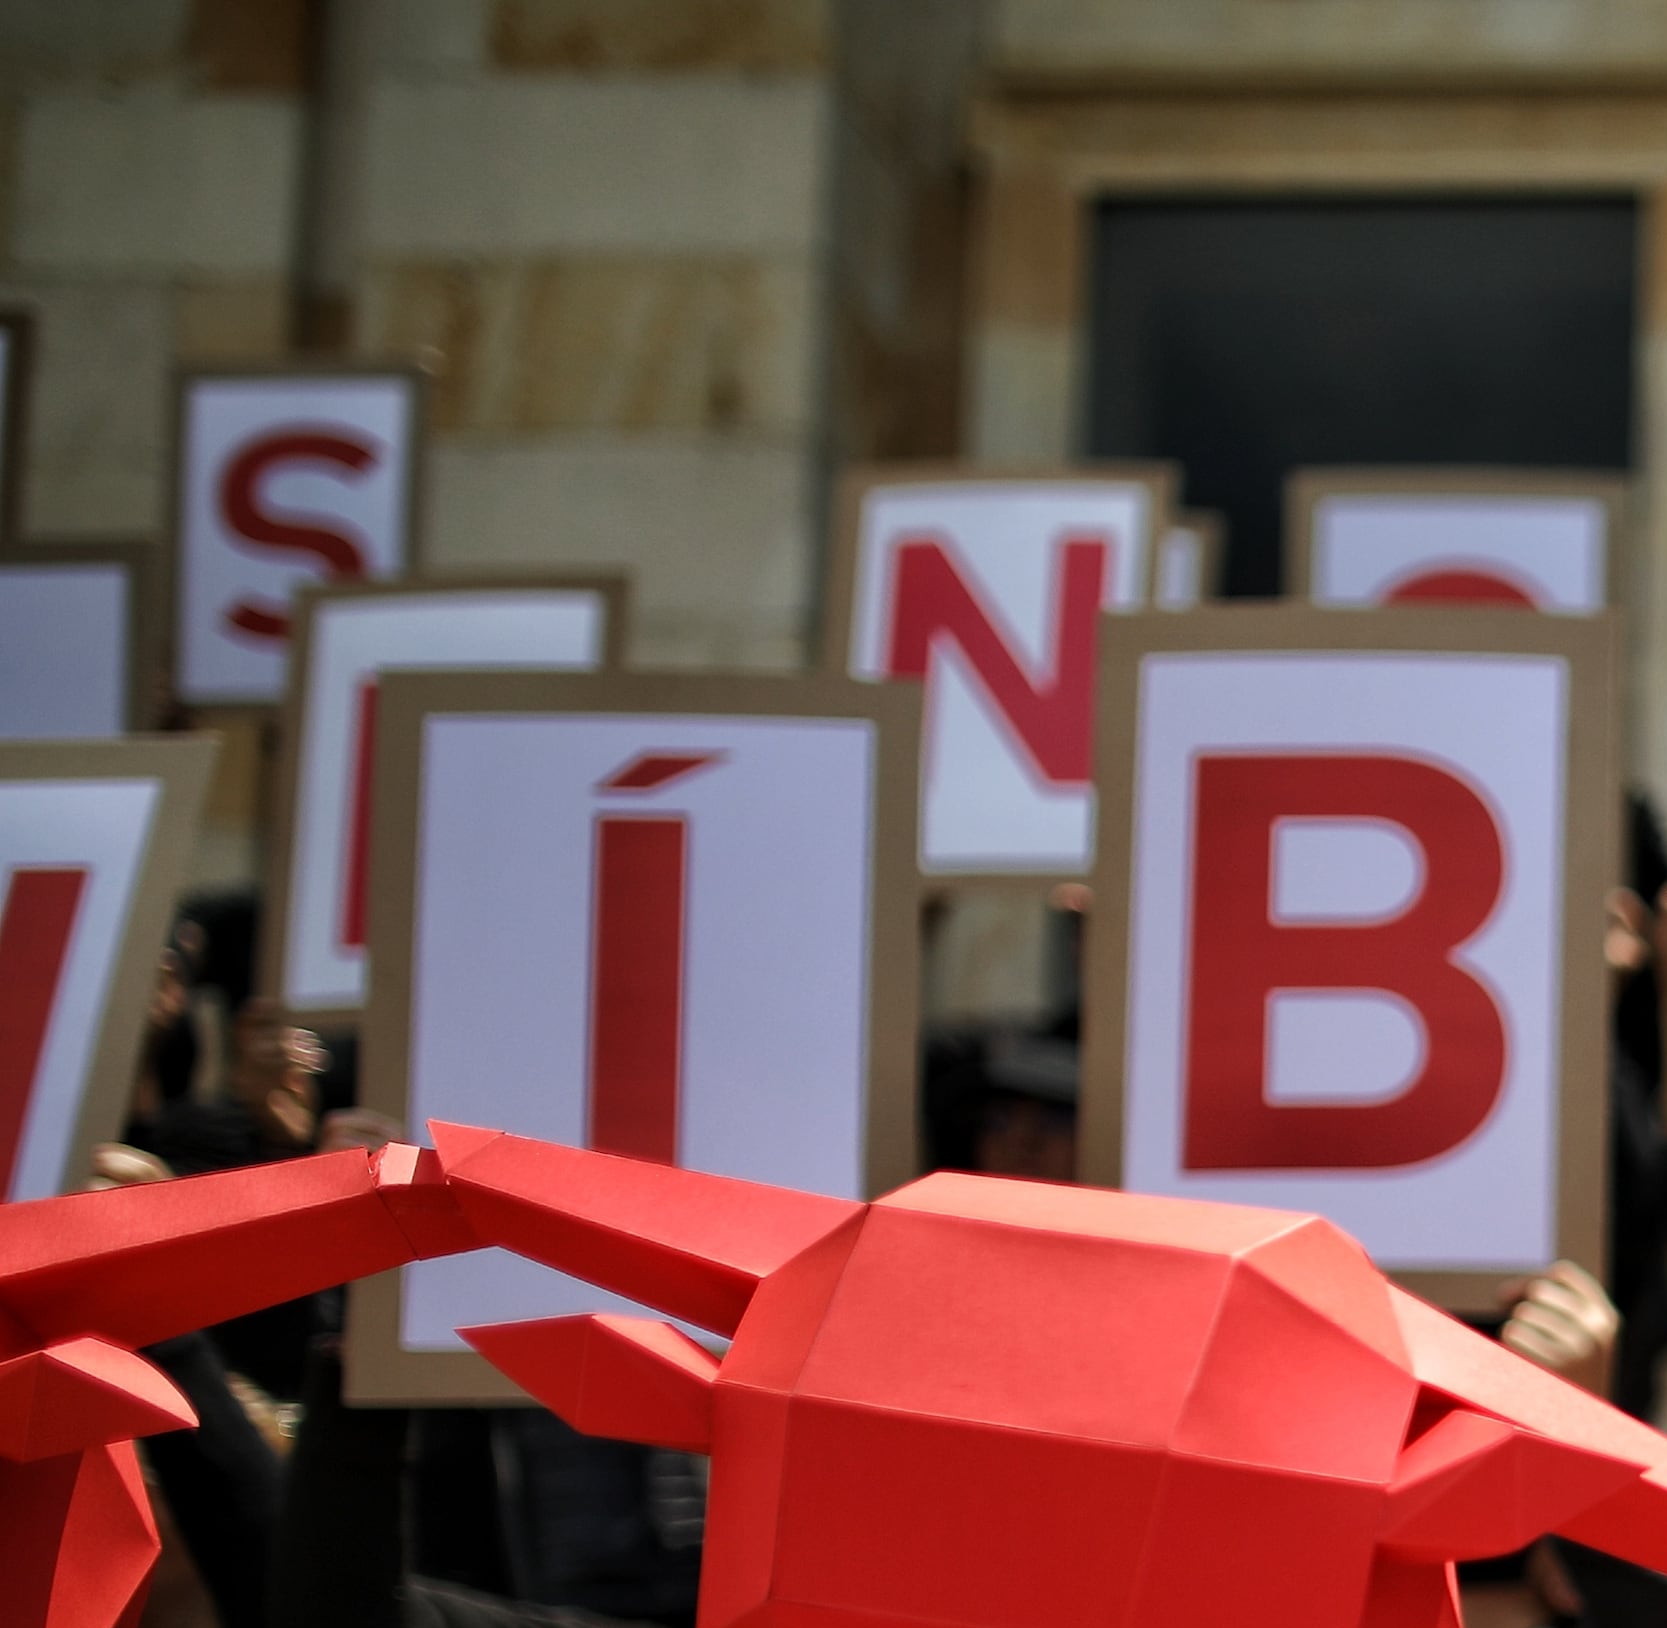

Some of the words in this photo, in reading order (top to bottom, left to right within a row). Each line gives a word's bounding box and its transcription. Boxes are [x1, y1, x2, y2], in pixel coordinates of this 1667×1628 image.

[215, 421, 383, 641] S
[884, 530, 1110, 790] N
[587, 747, 734, 1168] Í
[1179, 748, 1512, 1173] B
